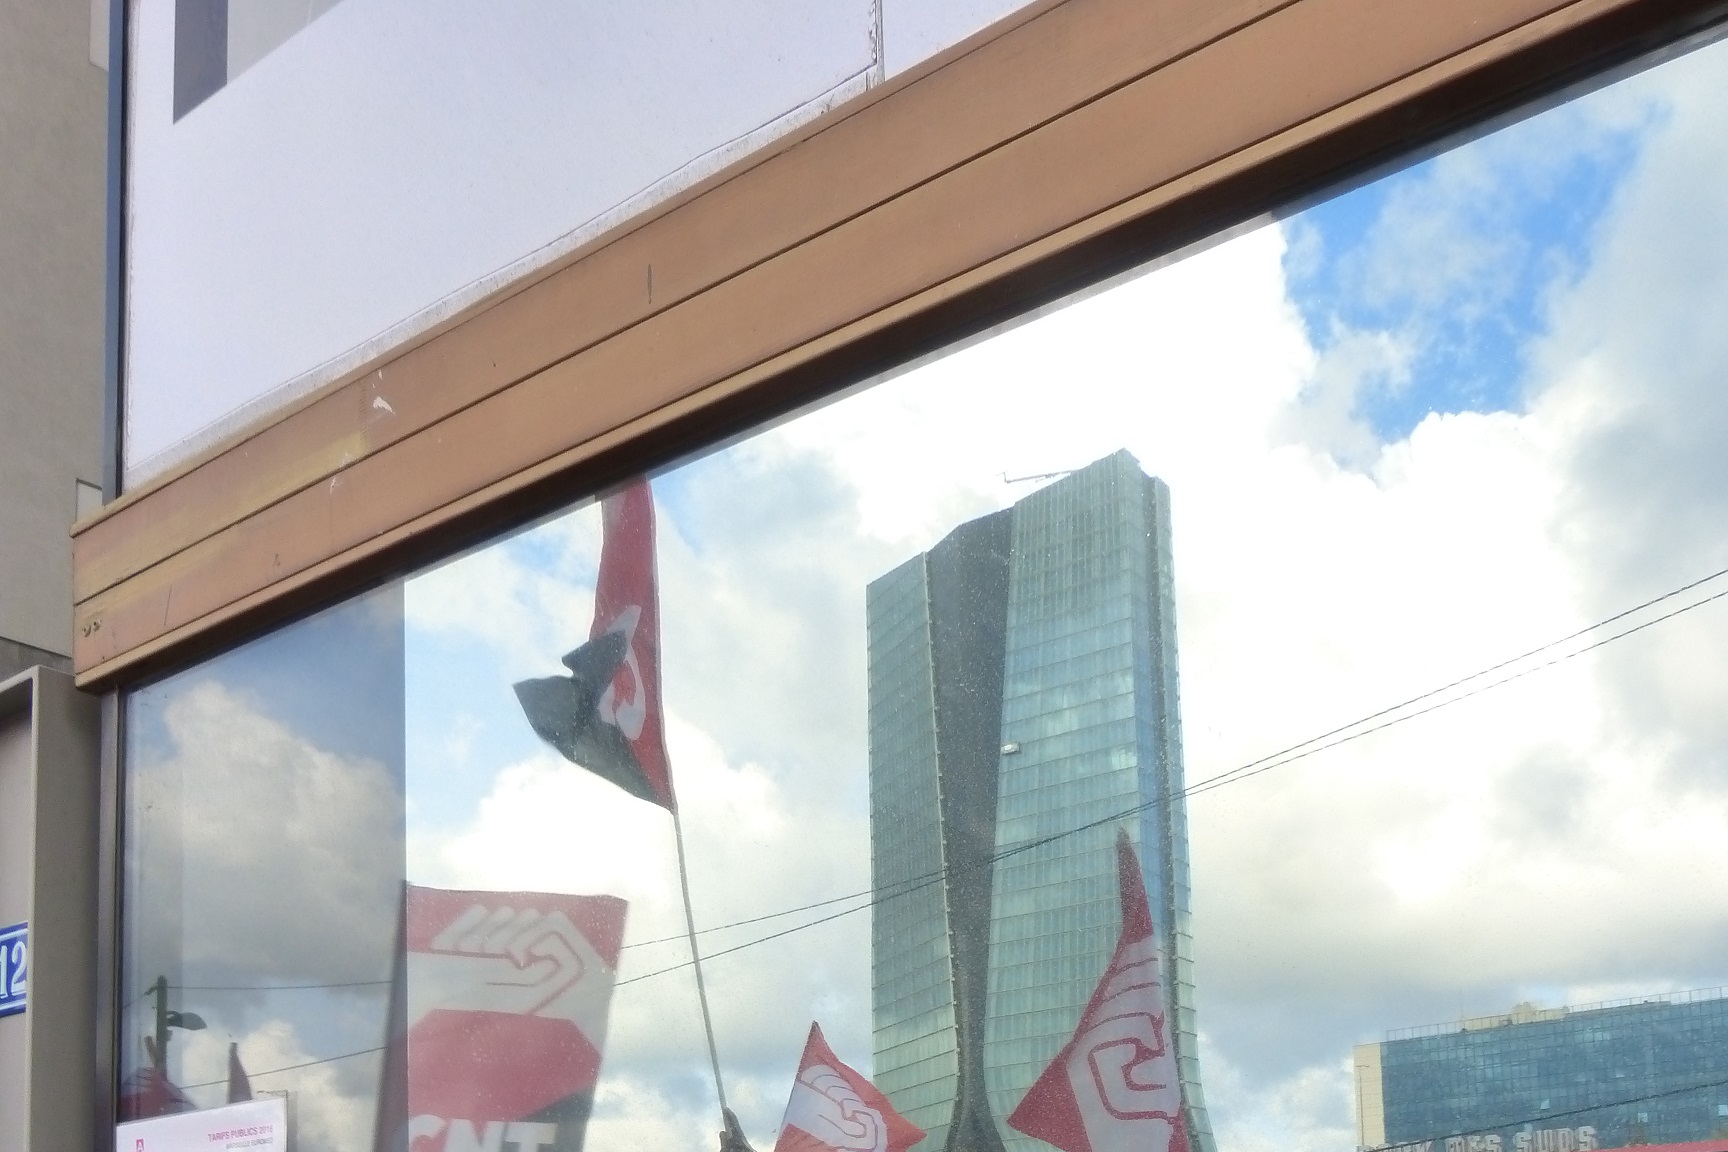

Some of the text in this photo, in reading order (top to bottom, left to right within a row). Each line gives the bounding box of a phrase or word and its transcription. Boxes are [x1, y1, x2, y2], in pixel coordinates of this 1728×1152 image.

[0, 941, 27, 999] 12
[208, 1132, 229, 1143] TARIFS
[231, 1127, 258, 1139] PUBLICS
